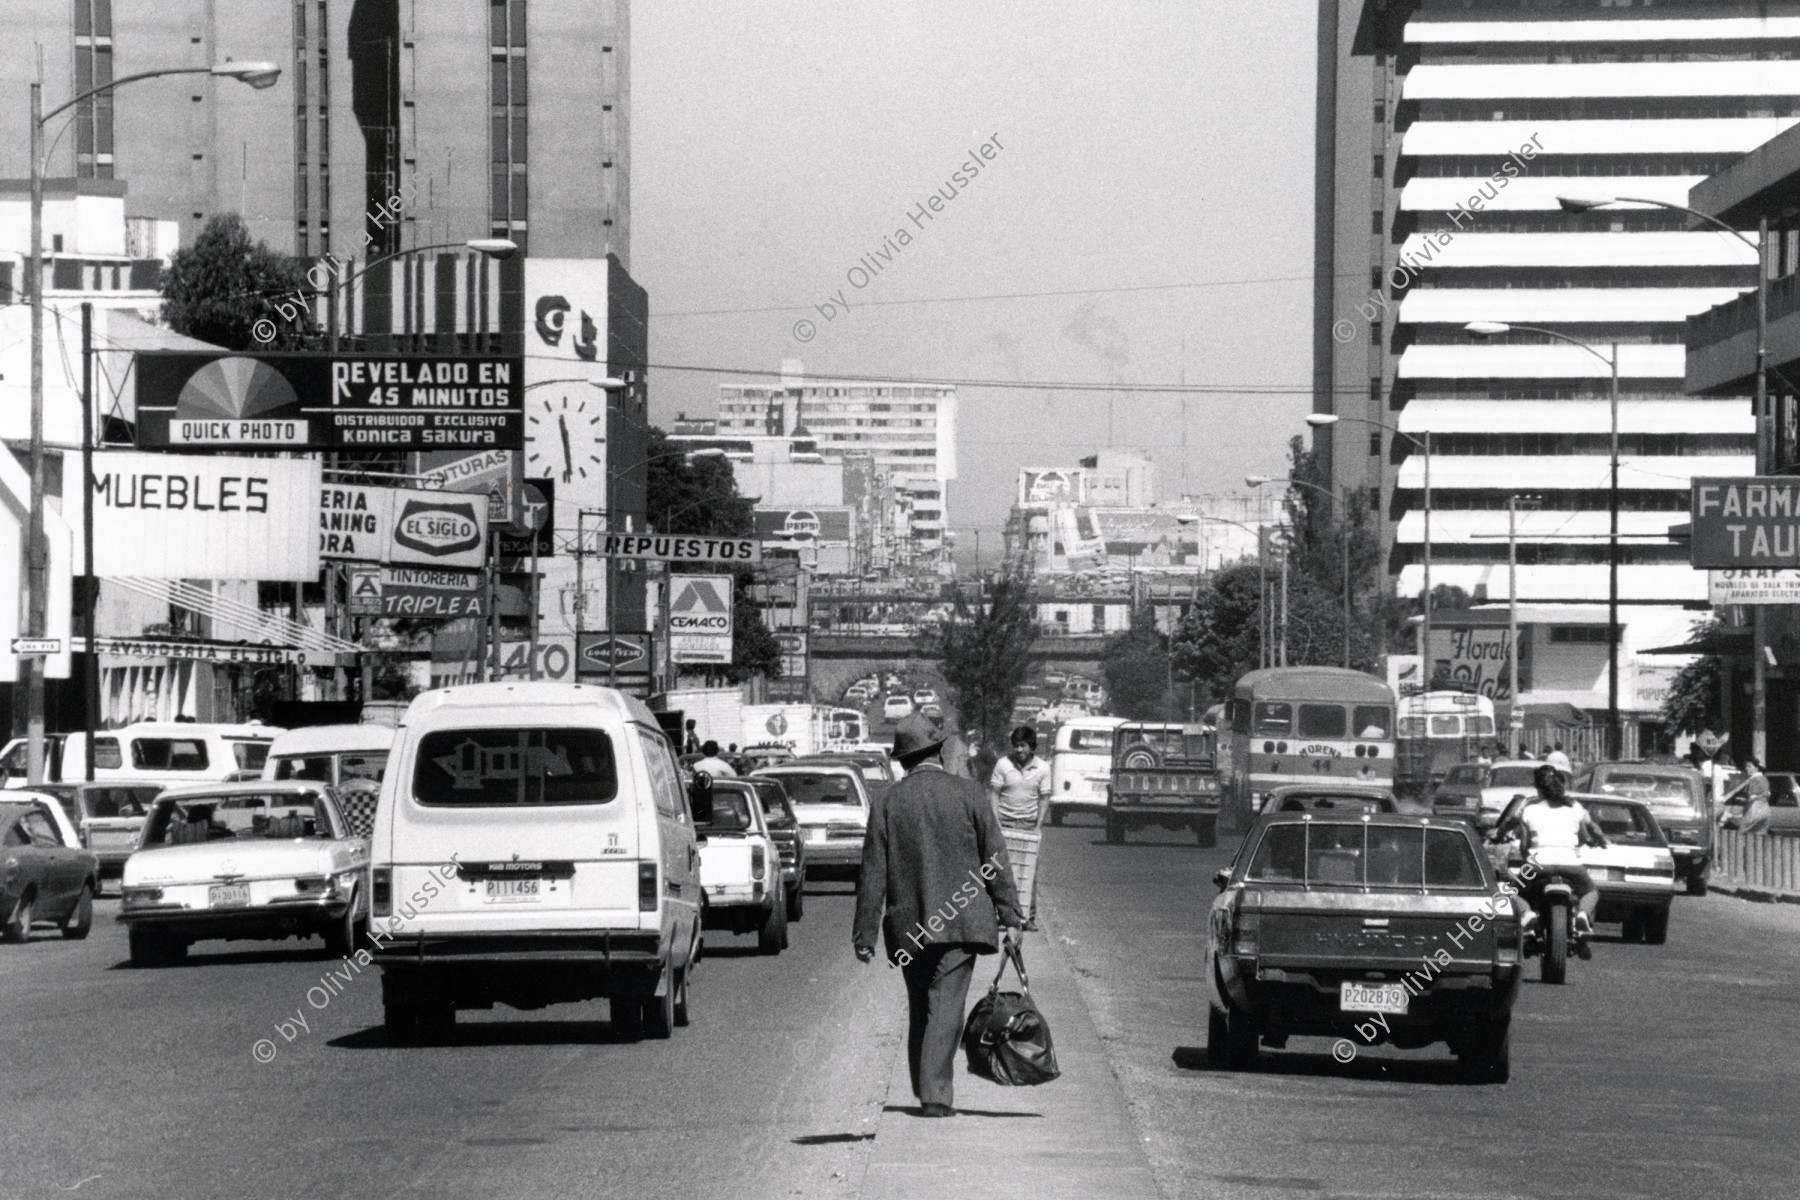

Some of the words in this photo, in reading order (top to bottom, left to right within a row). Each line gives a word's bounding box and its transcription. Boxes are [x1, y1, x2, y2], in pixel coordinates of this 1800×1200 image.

[332, 362, 469, 405] REVELADO
[478, 363, 511, 384] EN
[368, 388, 399, 406] 45
[412, 387, 510, 406] MINUTOS
[334, 414, 425, 427] DISTRIBUIDOR
[434, 415, 506, 428] EXCLUSIVO
[182, 423, 230, 441] QUICK
[240, 422, 295, 441] PHOTO
[91, 473, 269, 513] MUEBLES
[320, 489, 367, 511] ERIA
[1699, 484, 1800, 518] FARM
[320, 511, 377, 534] ANING
[406, 520, 422, 535] EL
[427, 521, 471, 537] SIGLO
[786, 522, 819, 531] PEPSI
[498, 540, 549, 552] EXAO
[604, 536, 754, 559] REPUESTOS
[1726, 524, 1800, 557] TAU
[389, 569, 469, 588] TINTORERIA
[385, 596, 461, 614] TRIPLE
[466, 597, 481, 615] A
[670, 616, 728, 628] CEMACO
[95, 640, 217, 659] LAVANDERIA
[230, 648, 249, 662] EL
[256, 649, 306, 665] SIGLO
[1299, 744, 1342, 761] MORENA
[1312, 759, 1332, 772] 44
[1129, 775, 1206, 791] TOYOTA
[487, 880, 538, 895] P111456
[1344, 988, 1400, 1005] P202879
